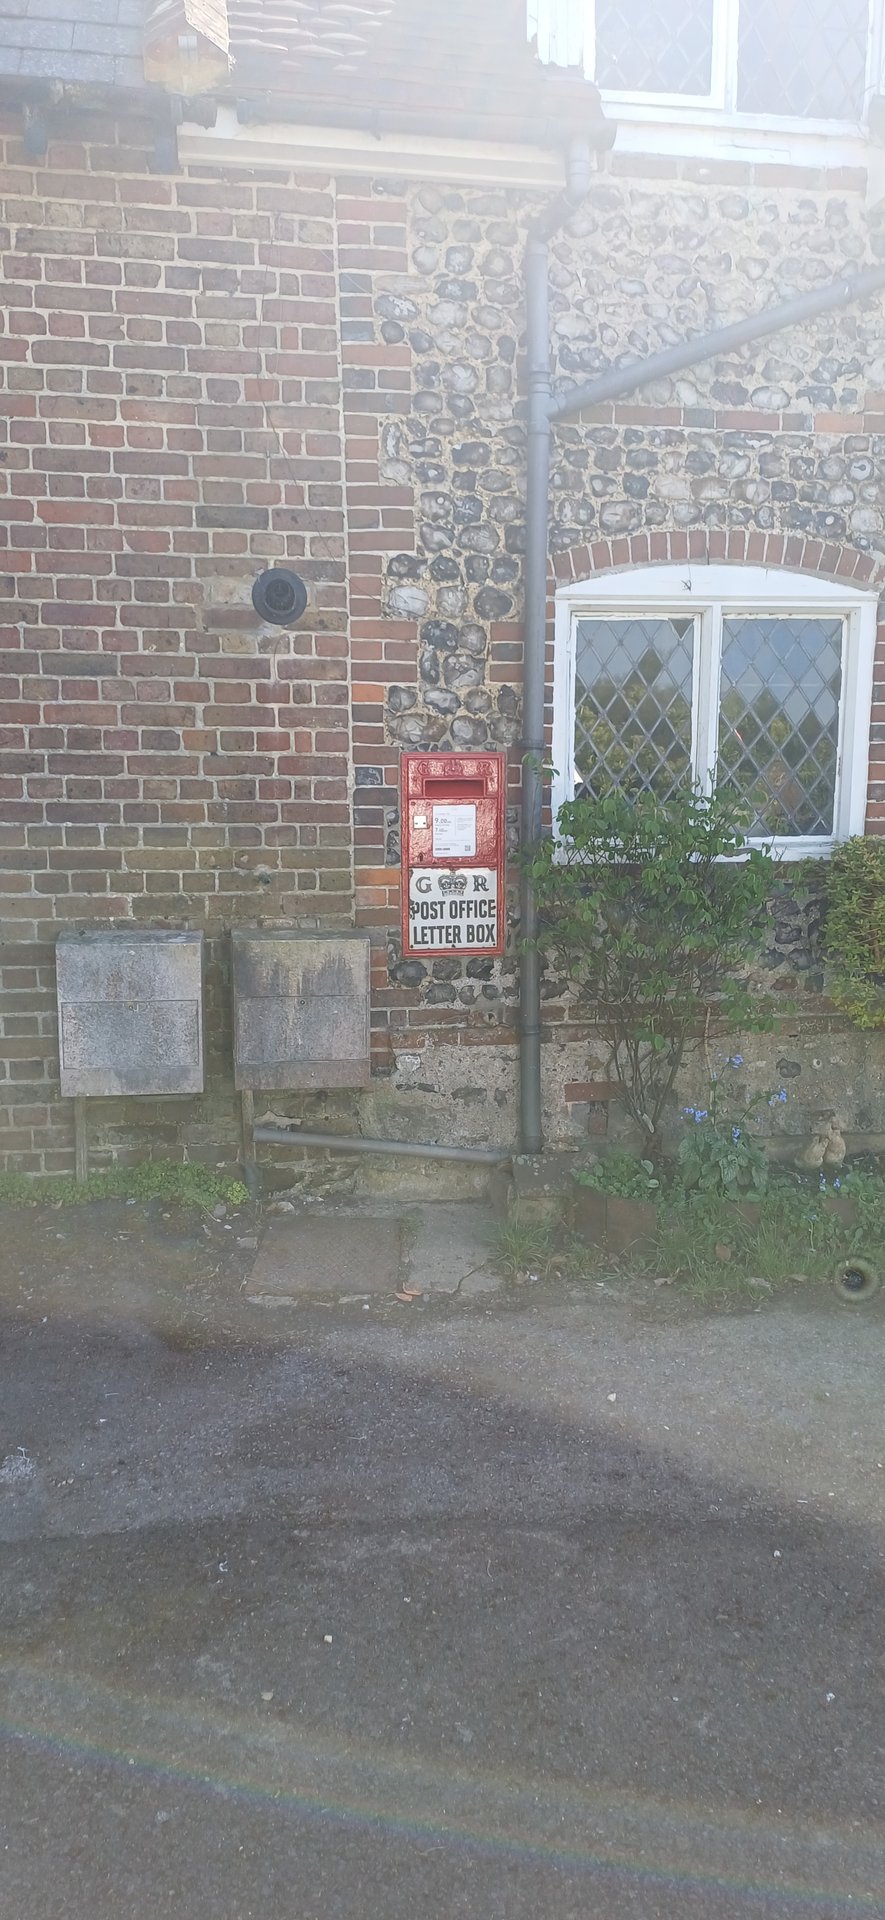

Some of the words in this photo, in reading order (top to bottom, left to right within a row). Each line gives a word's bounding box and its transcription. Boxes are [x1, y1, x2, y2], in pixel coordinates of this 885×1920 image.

[415, 876, 432, 893] G
[472, 875, 489, 892] R
[411, 900, 446, 920] POST
[449, 899, 496, 919] OFFICE
[413, 925, 462, 944] LETTER
[466, 924, 495, 943] BOX
